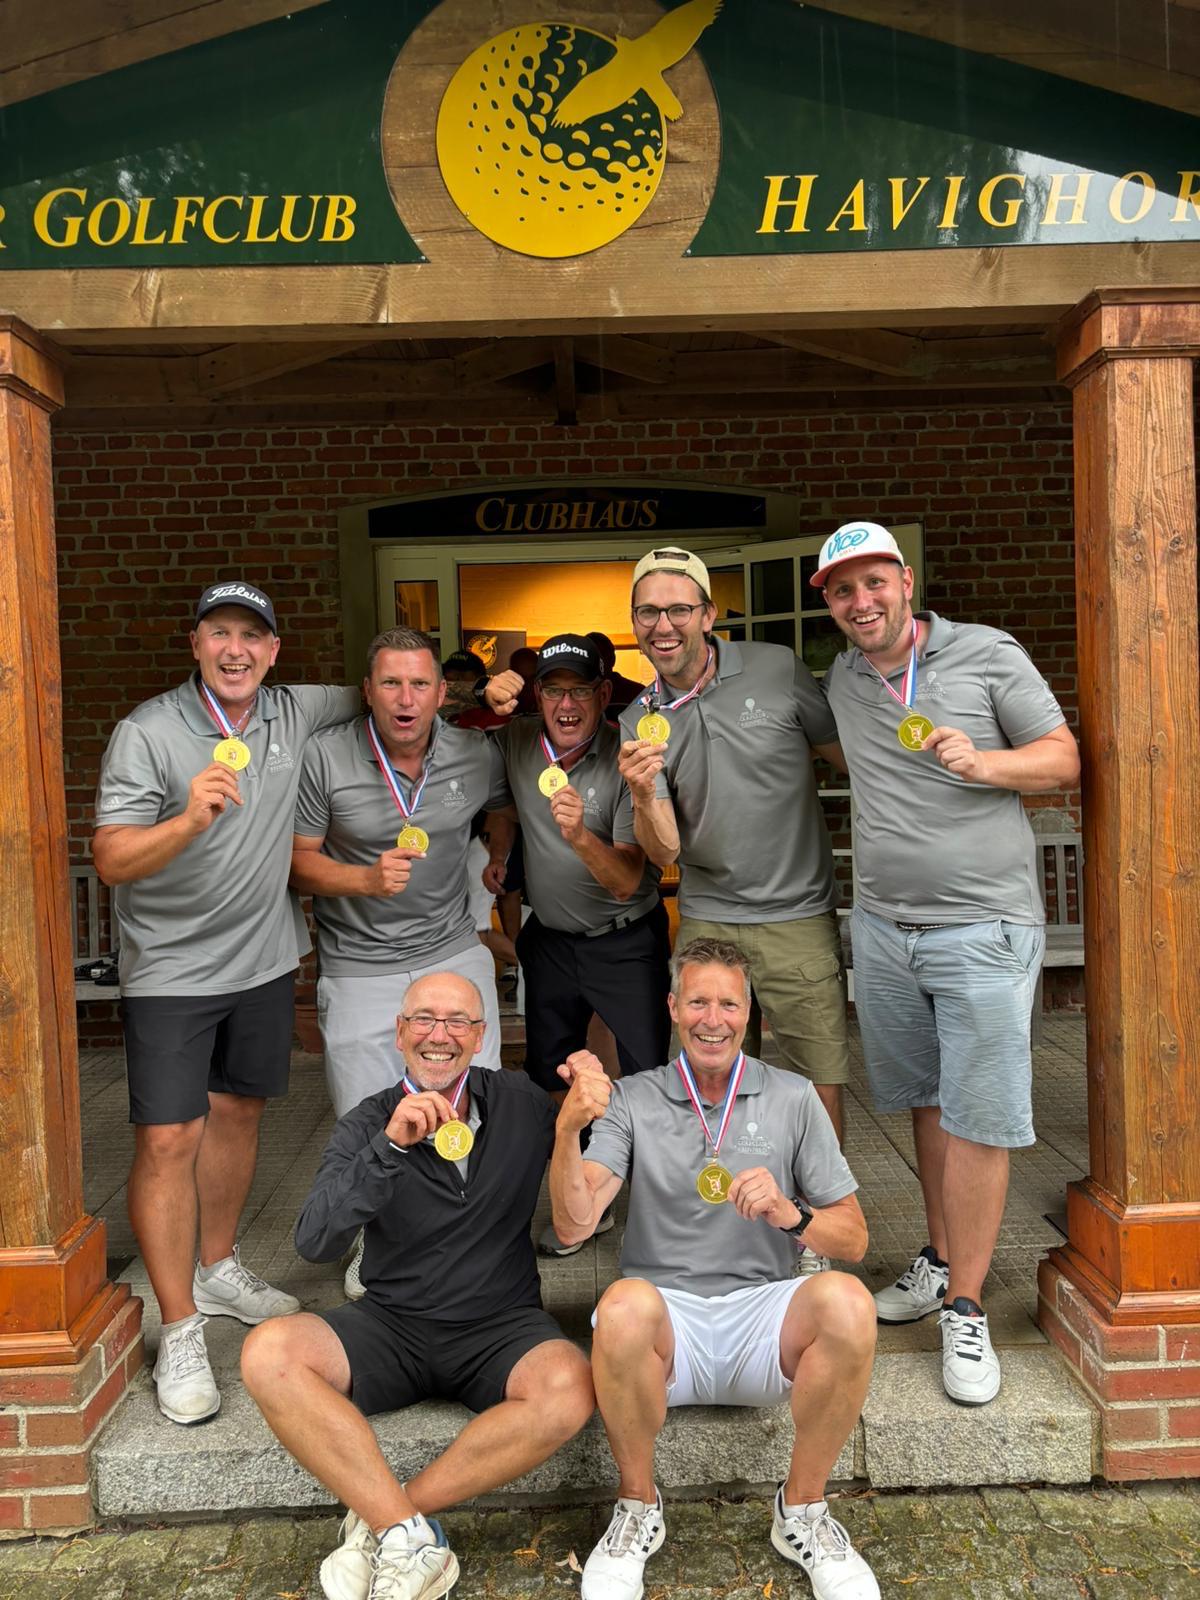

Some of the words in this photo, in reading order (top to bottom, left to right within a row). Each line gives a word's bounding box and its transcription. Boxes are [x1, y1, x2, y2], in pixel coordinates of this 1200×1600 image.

[34, 187, 357, 247] GOLFCLUB
[475, 497, 659, 532] CLUBHAUS
[207, 584, 267, 607] Titleist
[542, 642, 589, 658] Wilson
